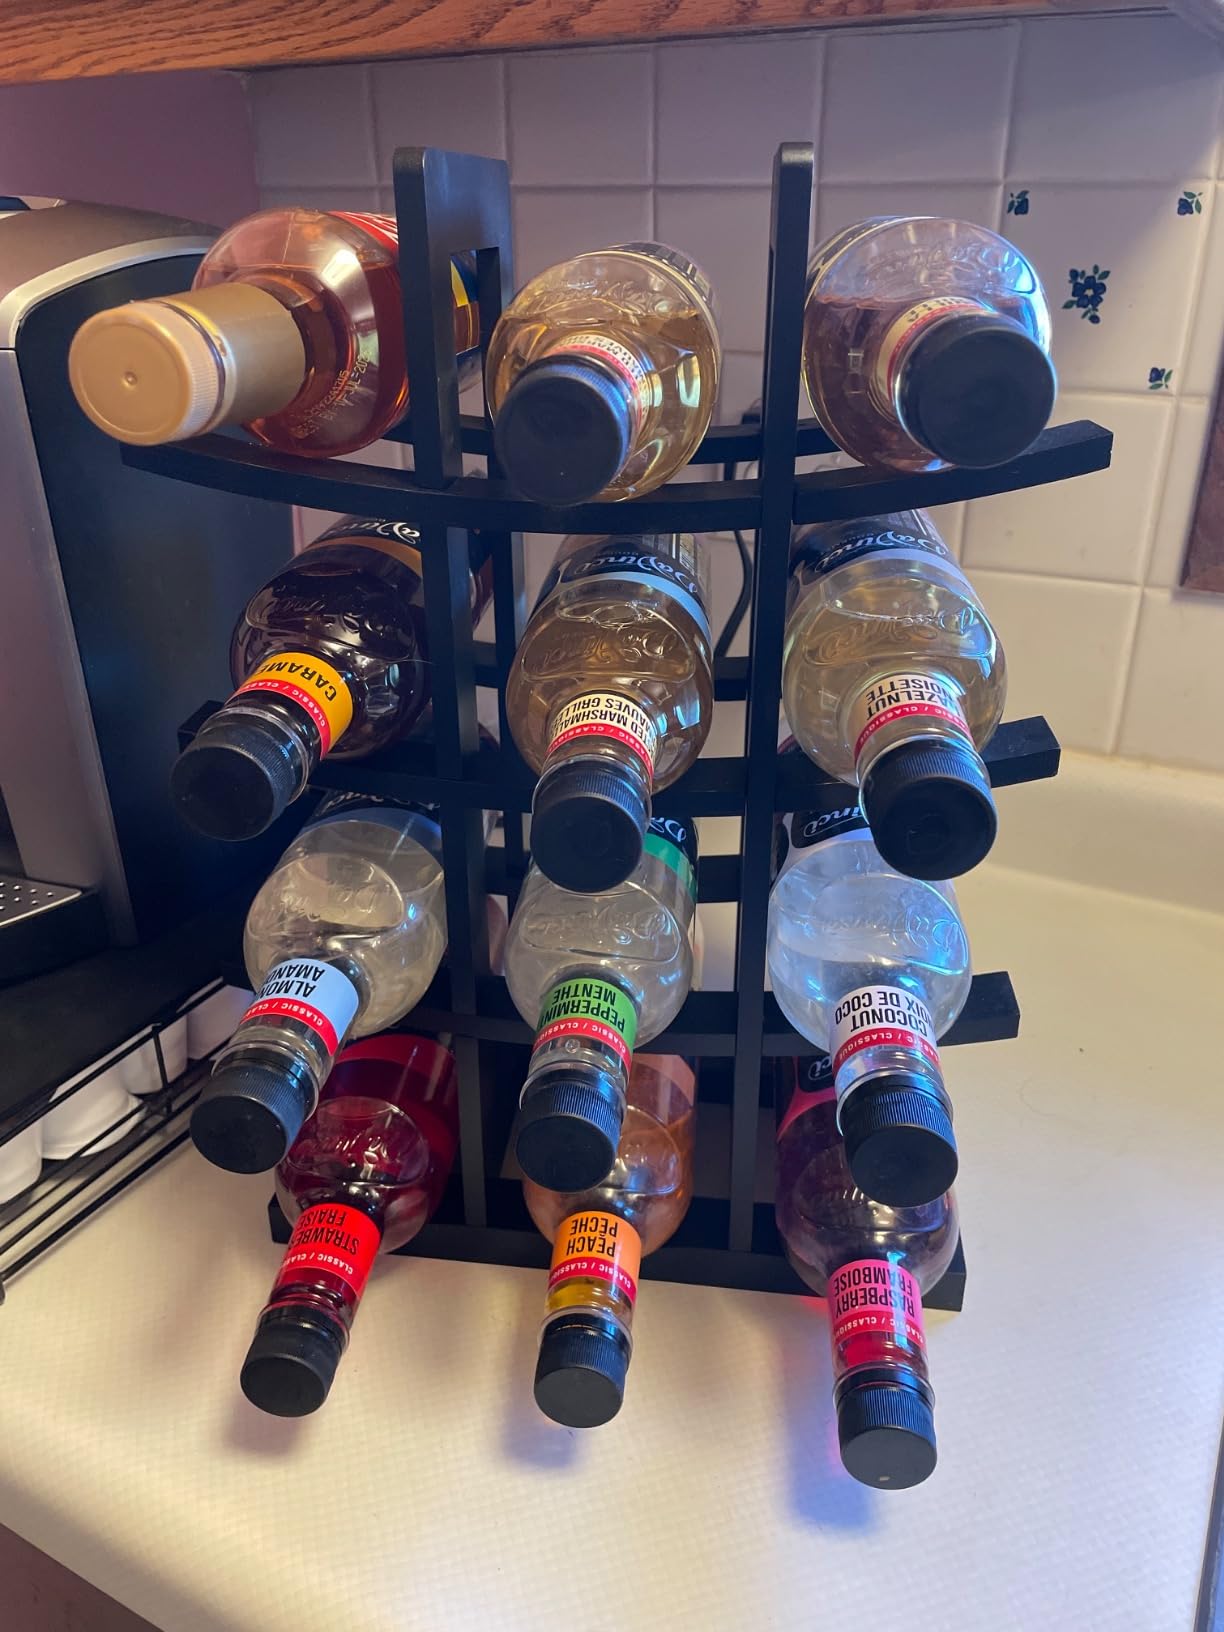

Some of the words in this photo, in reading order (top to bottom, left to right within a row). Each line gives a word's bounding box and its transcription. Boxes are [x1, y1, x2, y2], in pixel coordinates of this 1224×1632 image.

[551, 983, 617, 1006] MENTHE
[877, 991, 901, 1008] DE
[281, 1002, 323, 1026] CLASSIC
[834, 992, 873, 1025] COCO
[850, 1008, 928, 1037] COCONUT
[592, 1025, 626, 1053] CLASSIC
[569, 1217, 618, 1239] PÊCHE
[566, 1235, 616, 1258] PEACH
[316, 1252, 354, 1275] CLASSIC
[598, 1264, 632, 1289] CLASSIC
[833, 1266, 913, 1298] FRAMBOISE
[835, 1286, 915, 1319] RASPBERRY
